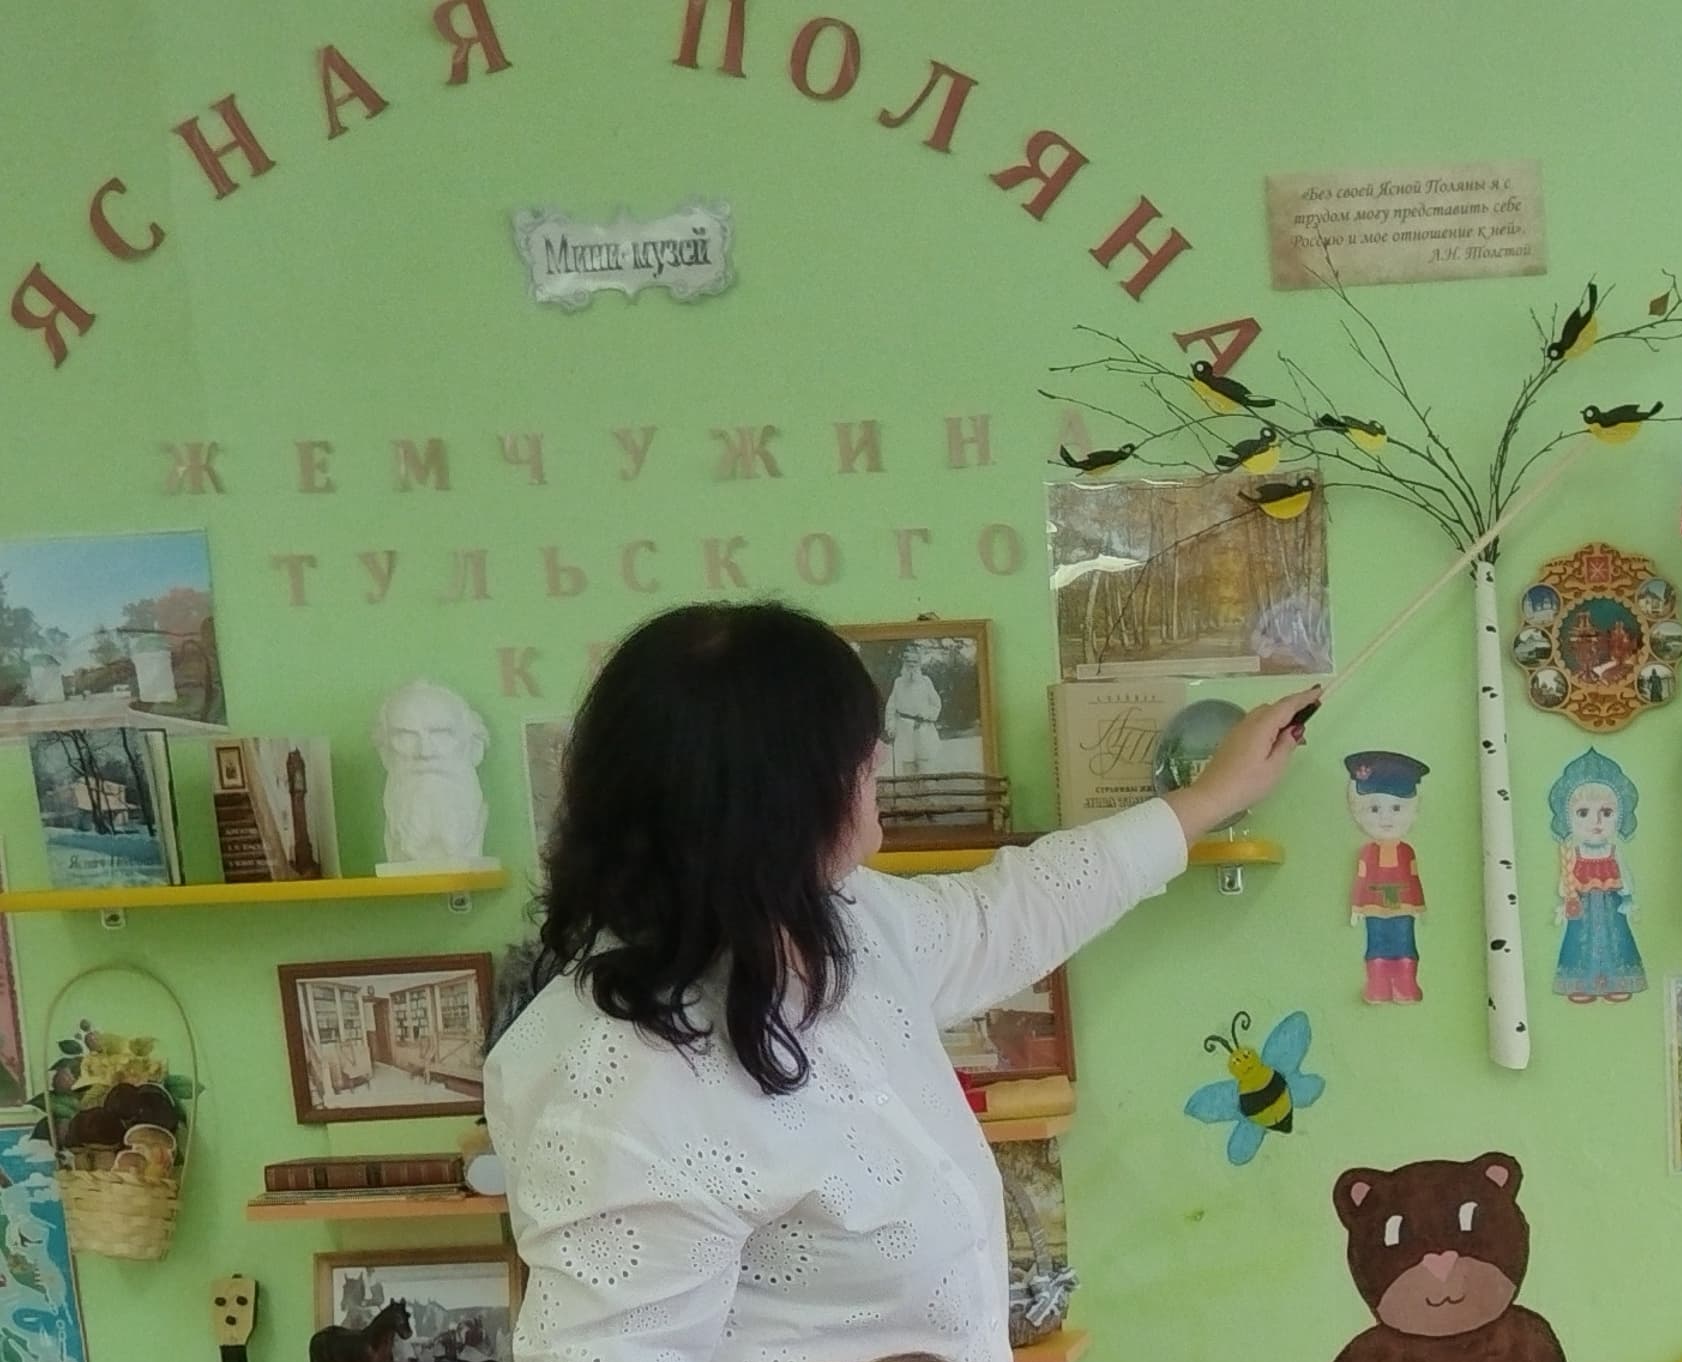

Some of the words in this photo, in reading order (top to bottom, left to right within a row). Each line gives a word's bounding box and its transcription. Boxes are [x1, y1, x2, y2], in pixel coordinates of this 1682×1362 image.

[10, 0, 513, 368] ЯСНАЯ
[672, 0, 1262, 377] ПОЛЯНА
[1336, 181, 1374, 199] своей
[1377, 180, 1422, 199] Ясной
[1424, 178, 1486, 197] Поляны
[1294, 209, 1350, 229] трудом
[1356, 208, 1390, 225] могу
[1393, 202, 1489, 224] представить
[1493, 197, 1521, 213] себе
[1392, 228, 1473, 243] отношение
[1464, 243, 1531, 261] Толстой
[161, 408, 1096, 496] ЖЕМЧУЖИНА
[271, 522, 1024, 607] ТУЛЬСКОГО
